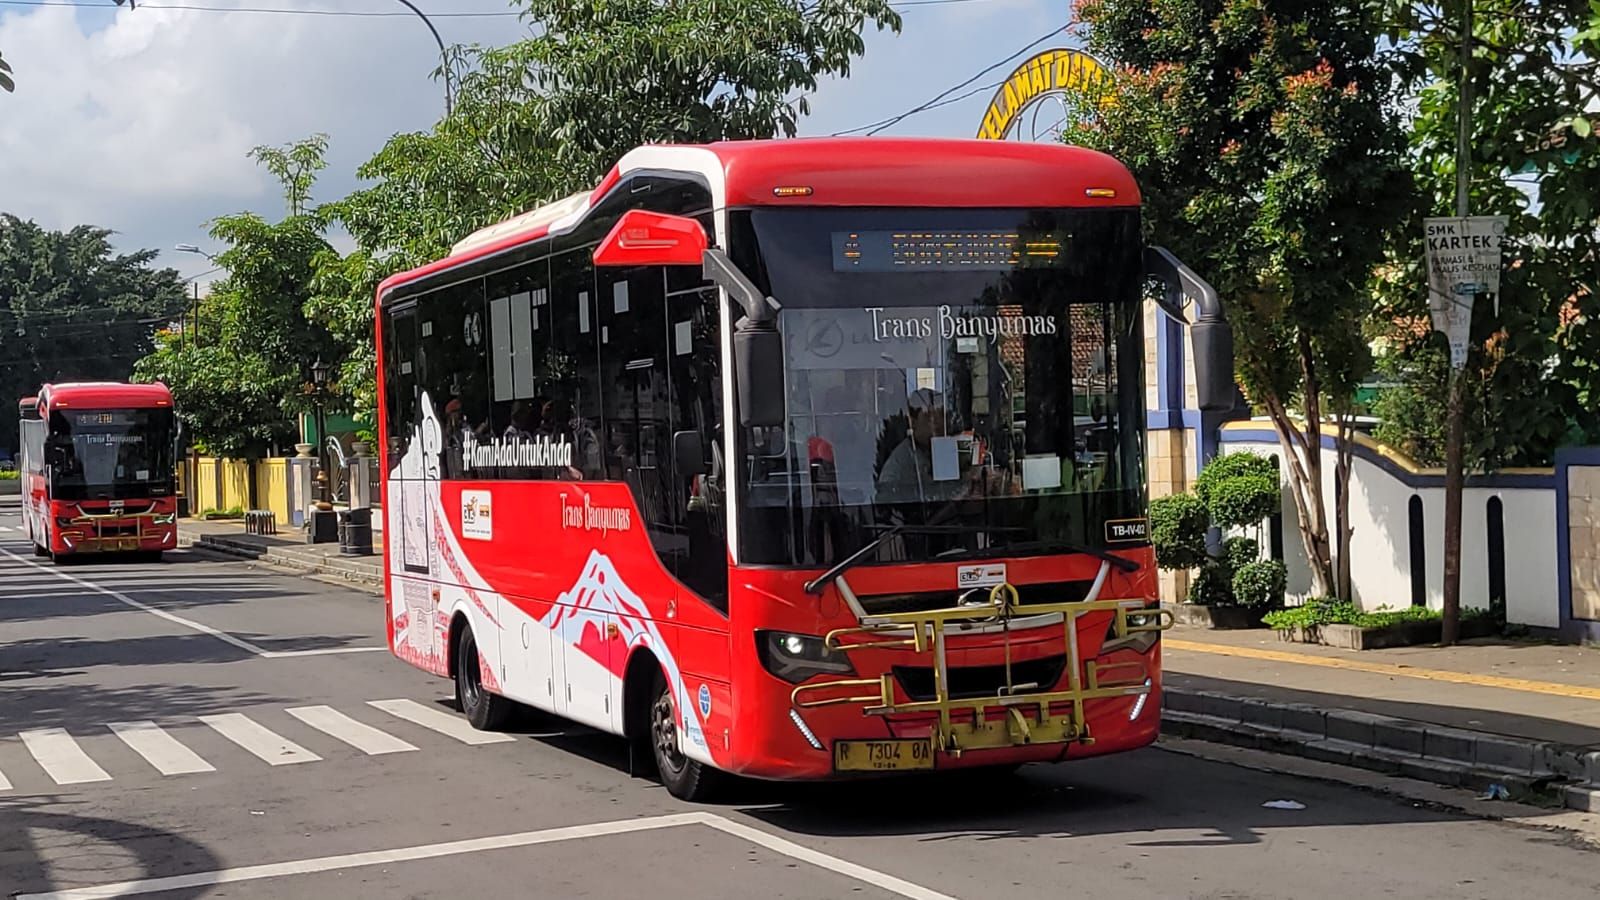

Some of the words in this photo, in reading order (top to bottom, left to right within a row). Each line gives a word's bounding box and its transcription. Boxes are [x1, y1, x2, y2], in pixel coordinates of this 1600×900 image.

[1428, 225, 1456, 236] SMK
[1428, 235, 1492, 251] KARTEK
[865, 307, 933, 342] Trans
[939, 305, 1056, 345] Banyumas
[463, 431, 571, 471] #KamiAdaUntukAnda
[560, 493, 583, 530] Trans
[584, 492, 631, 539] Banyumas
[1112, 524, 1146, 537] TB-IV-02
[840, 743, 849, 761] R
[866, 743, 901, 761] 7304
